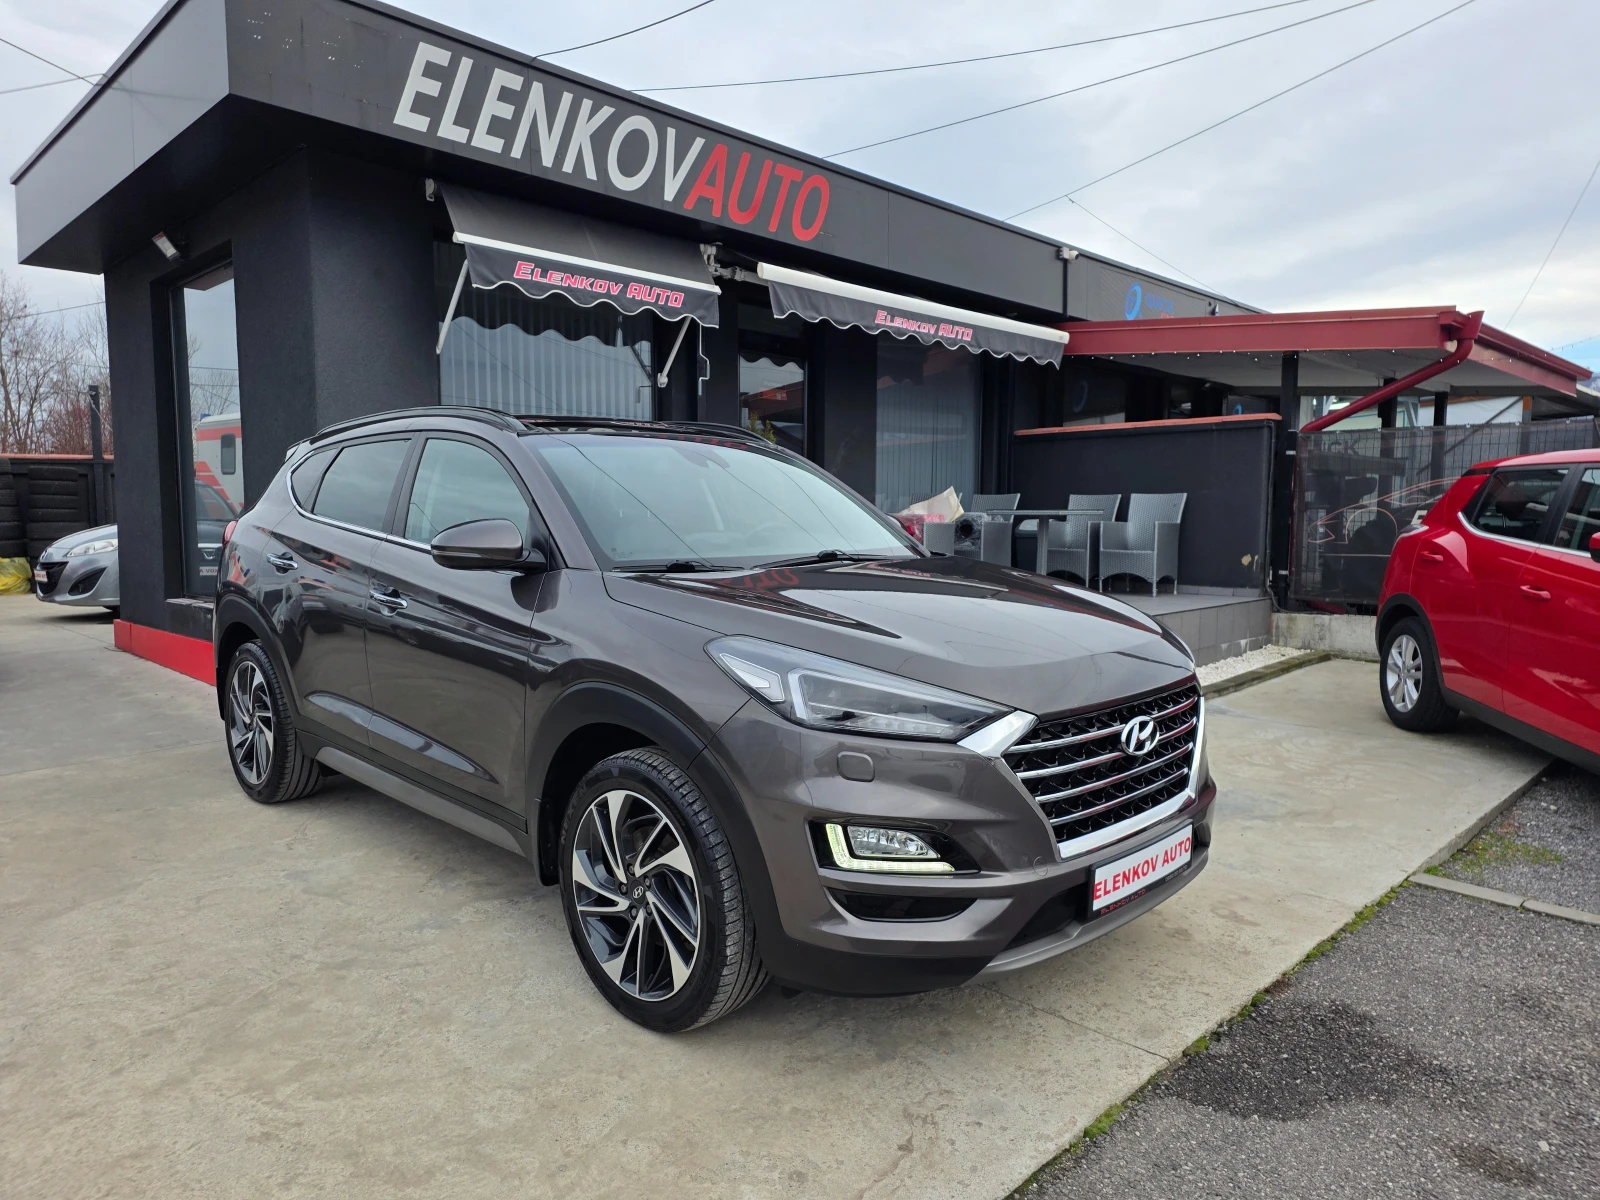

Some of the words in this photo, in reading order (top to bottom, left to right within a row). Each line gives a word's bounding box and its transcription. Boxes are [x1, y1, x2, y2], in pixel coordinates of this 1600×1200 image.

[626, 282, 684, 308] AUTO
[938, 323, 973, 341] AUTO
[1093, 854, 1159, 901] ELENKOV
[1161, 836, 1191, 867] AUTO
